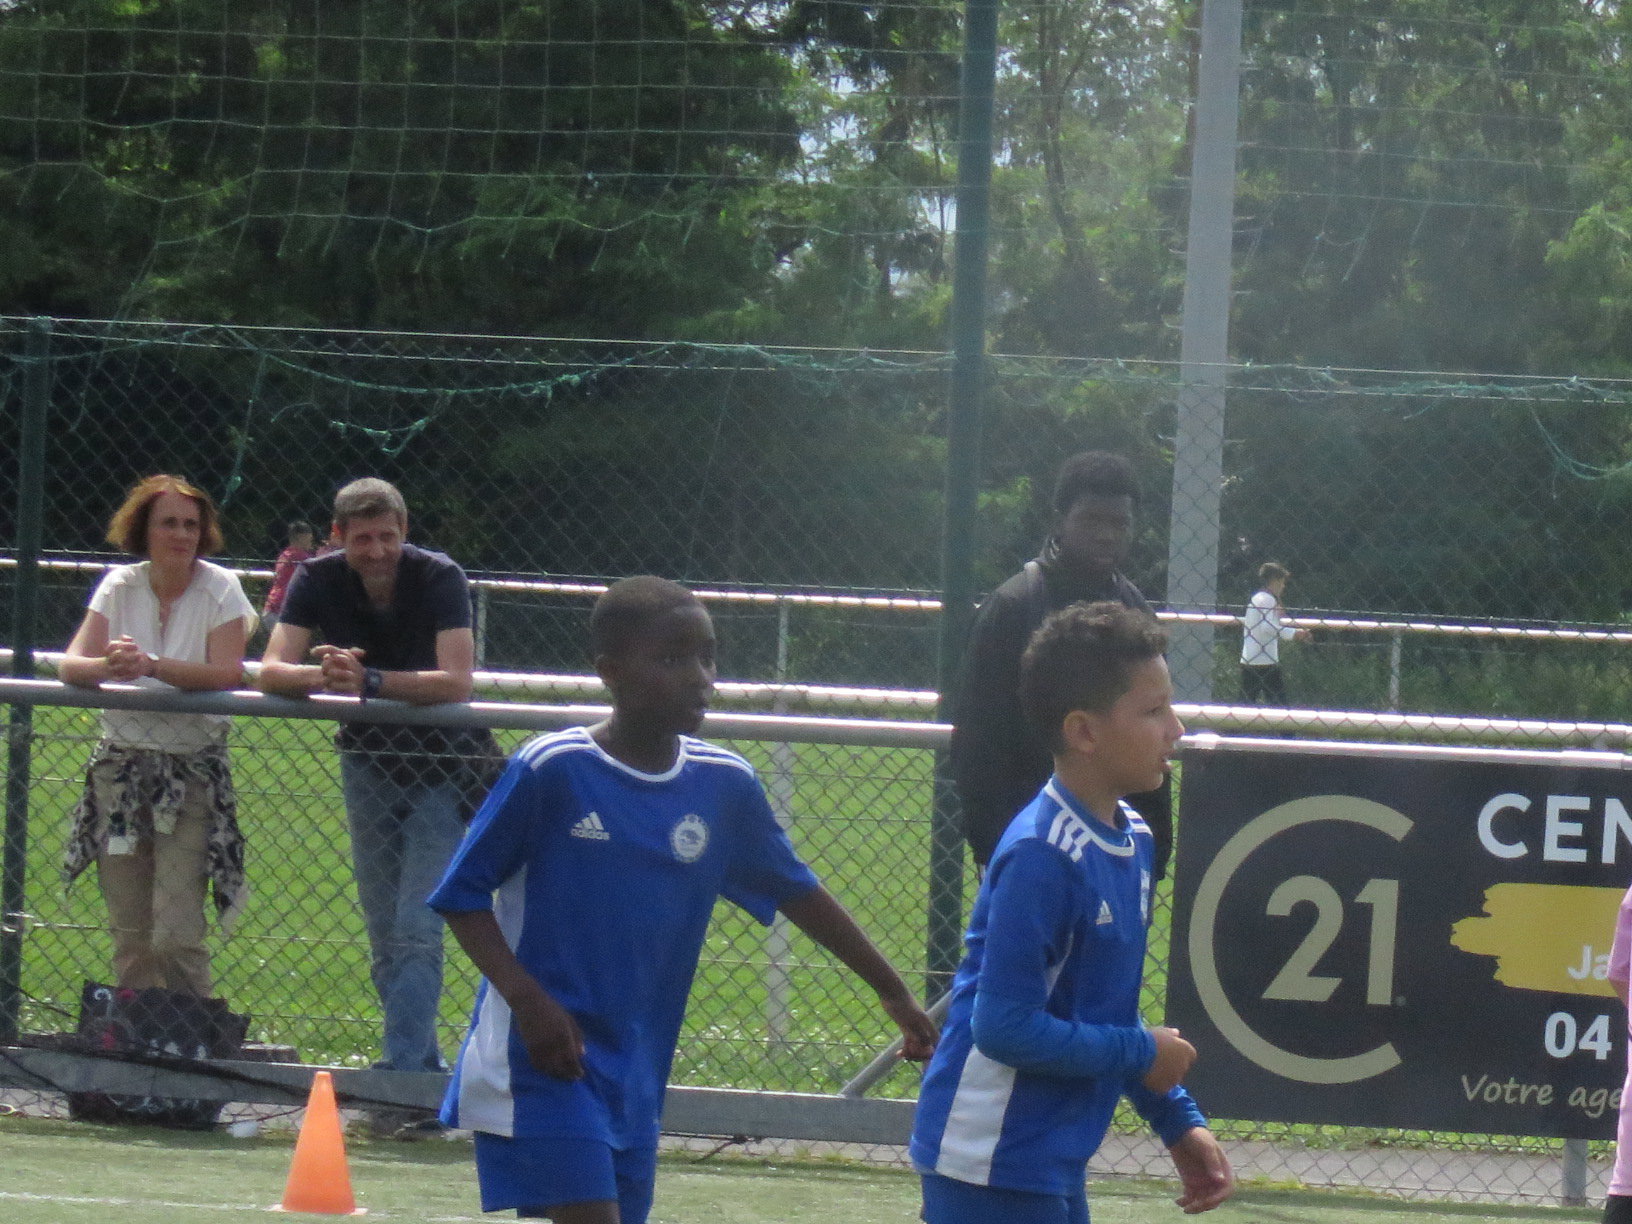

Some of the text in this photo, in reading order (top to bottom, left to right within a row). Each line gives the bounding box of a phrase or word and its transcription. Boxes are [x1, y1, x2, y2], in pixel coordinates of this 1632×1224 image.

[1262, 875, 1398, 1005] 21
[1544, 1012, 1612, 1060] 04
[1461, 1074, 1554, 1106] Votre
[1568, 1086, 1625, 1119] age
